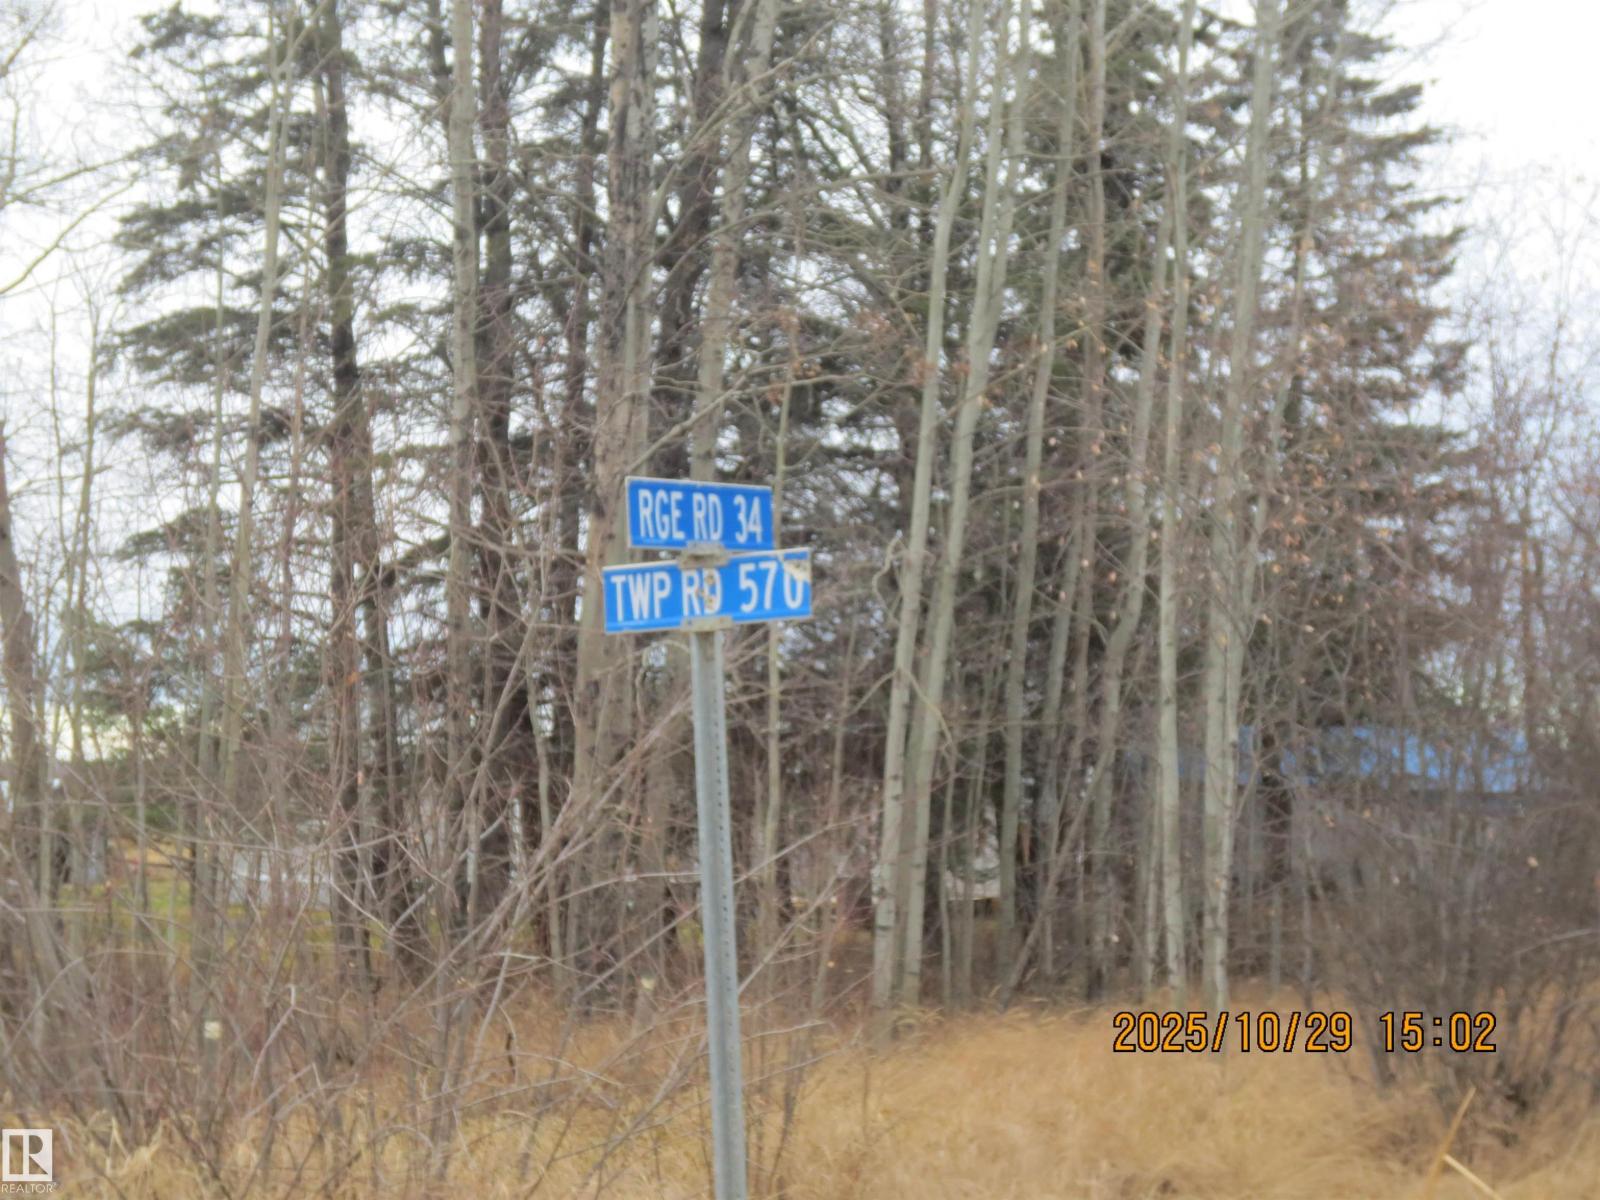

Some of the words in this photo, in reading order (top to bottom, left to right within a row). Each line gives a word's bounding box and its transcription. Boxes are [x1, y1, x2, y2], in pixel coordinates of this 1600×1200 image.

[638, 488, 686, 540] RGE
[692, 492, 724, 541] RD
[733, 494, 763, 544] 34
[610, 571, 672, 622] TWP
[681, 567, 722, 616] RD
[738, 560, 804, 614] 570
